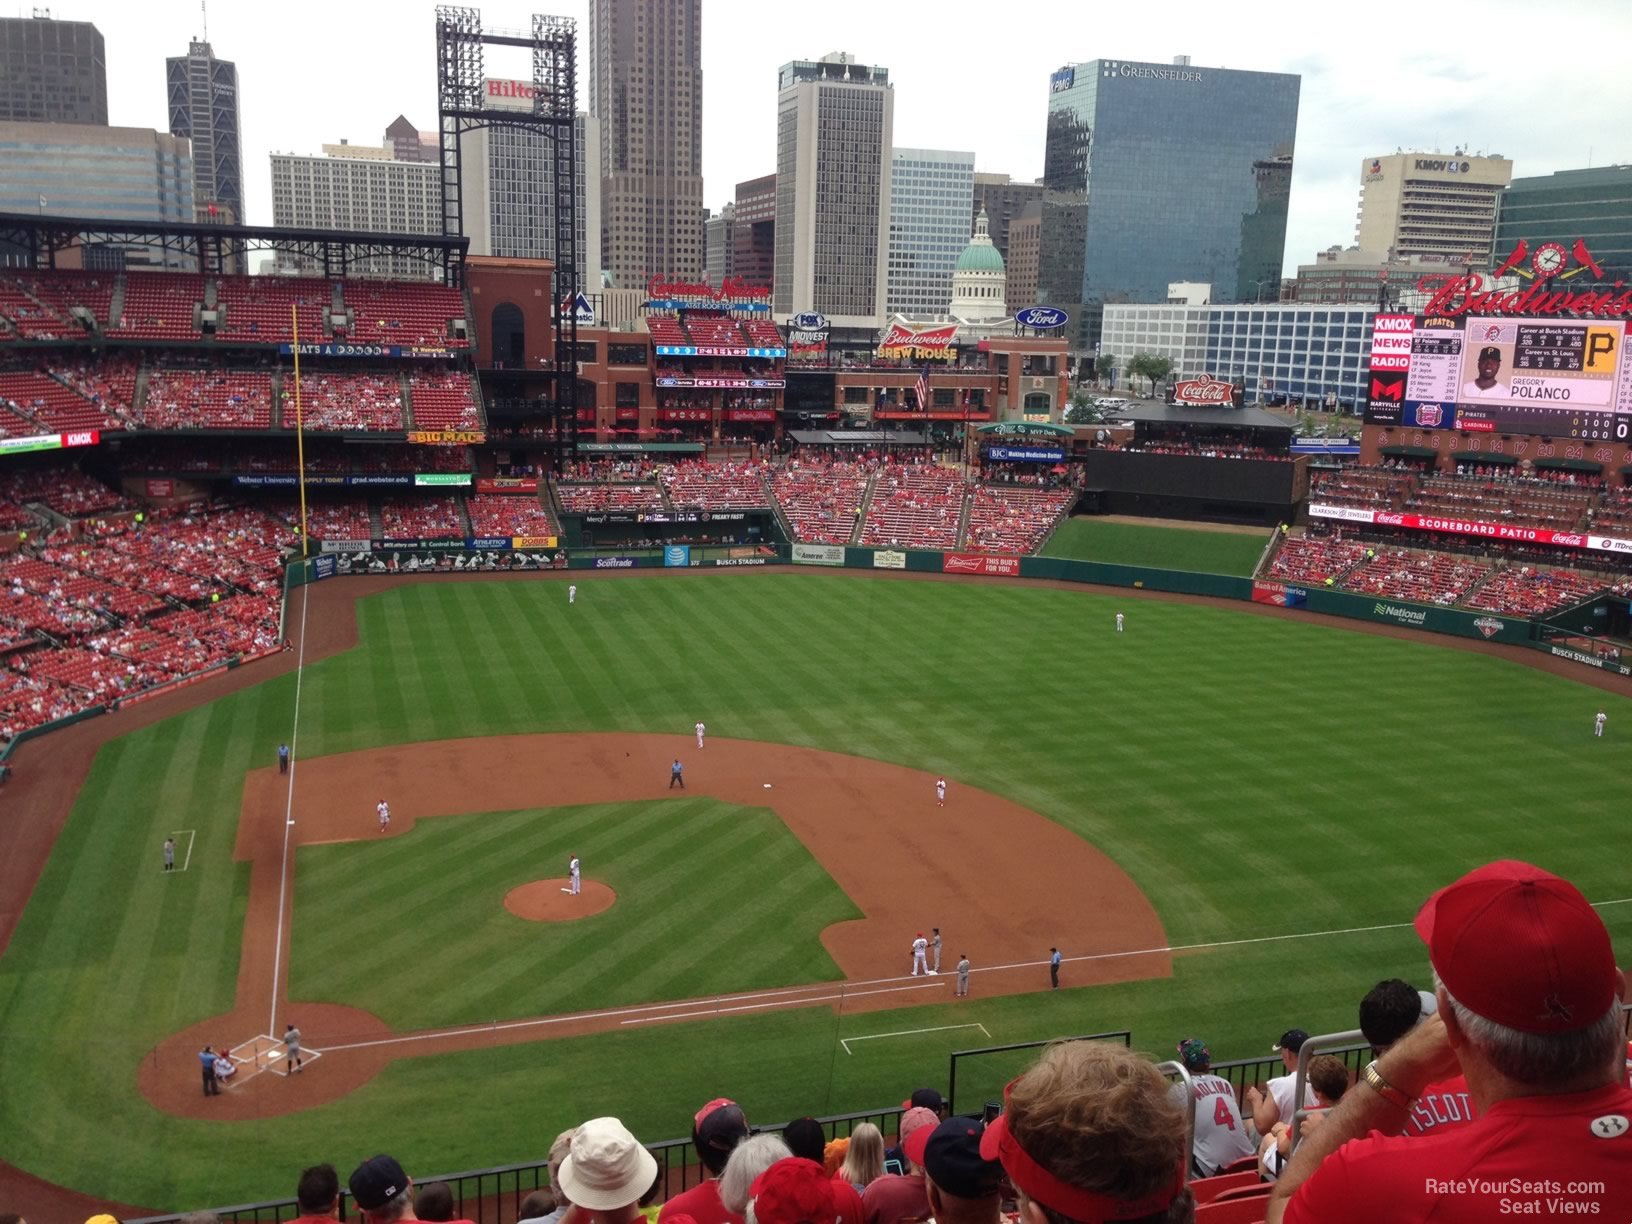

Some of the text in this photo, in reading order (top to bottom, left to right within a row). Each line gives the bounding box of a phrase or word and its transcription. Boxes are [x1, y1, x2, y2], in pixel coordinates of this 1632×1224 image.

[1120, 64, 1203, 82] GREENSFELDER
[1050, 78, 1070, 92] KPMG
[1415, 160, 1446, 171] KMOV
[800, 315, 818, 324] FOX
[1027, 310, 1058, 324] Ford
[1375, 318, 1413, 330] KMOX
[1424, 318, 1455, 328] PIRATES
[790, 331, 829, 341] MIDWEST
[878, 330, 957, 345] Budweiser
[1373, 338, 1411, 348] NEWS
[325, 345, 332, 354] A
[877, 347, 958, 359] BREW HOUSE
[1587, 332, 1615, 367] P
[1371, 357, 1409, 367] RADIO
[1512, 378, 1546, 386] GREGORY
[1511, 386, 1570, 400] POLANCO
[1573, 418, 1579, 426] 0
[1464, 421, 1493, 429] CARDINALS
[1571, 429, 1577, 437] 0
[1582, 430, 1588, 438] 0
[1592, 430, 1598, 438] 0
[1616, 424, 1628, 439] 0
[67, 432, 92, 446] KMOX
[416, 432, 477, 443] BIG MAC
[1400, 432, 1613, 462] 1 2 6 9 10 14 17 20 24 42
[991, 449, 1006, 458] BJC
[1008, 451, 1025, 459] Making
[1026, 451, 1047, 459] Medicine
[237, 476, 263, 484] Webster
[264, 476, 296, 485] University
[352, 476, 409, 485] grad.webster.edu
[1311, 507, 1338, 515] CLARKSON
[587, 515, 602, 523] Mercy
[1377, 513, 1582, 546] Coca-Cola SCOREBOARD PATIO Coca-Cola
[473, 538, 506, 546] ATHLETICO
[801, 552, 824, 560] Ameren
[597, 558, 633, 567] Scottrade
[985, 558, 1018, 567] THIS BUD'S
[1254, 581, 1271, 590] Bank
[1278, 585, 1307, 596] America
[1385, 606, 1426, 620] National
[1551, 646, 1603, 668] BUSCH STADIUM
[1214, 1096, 1236, 1131] 4
